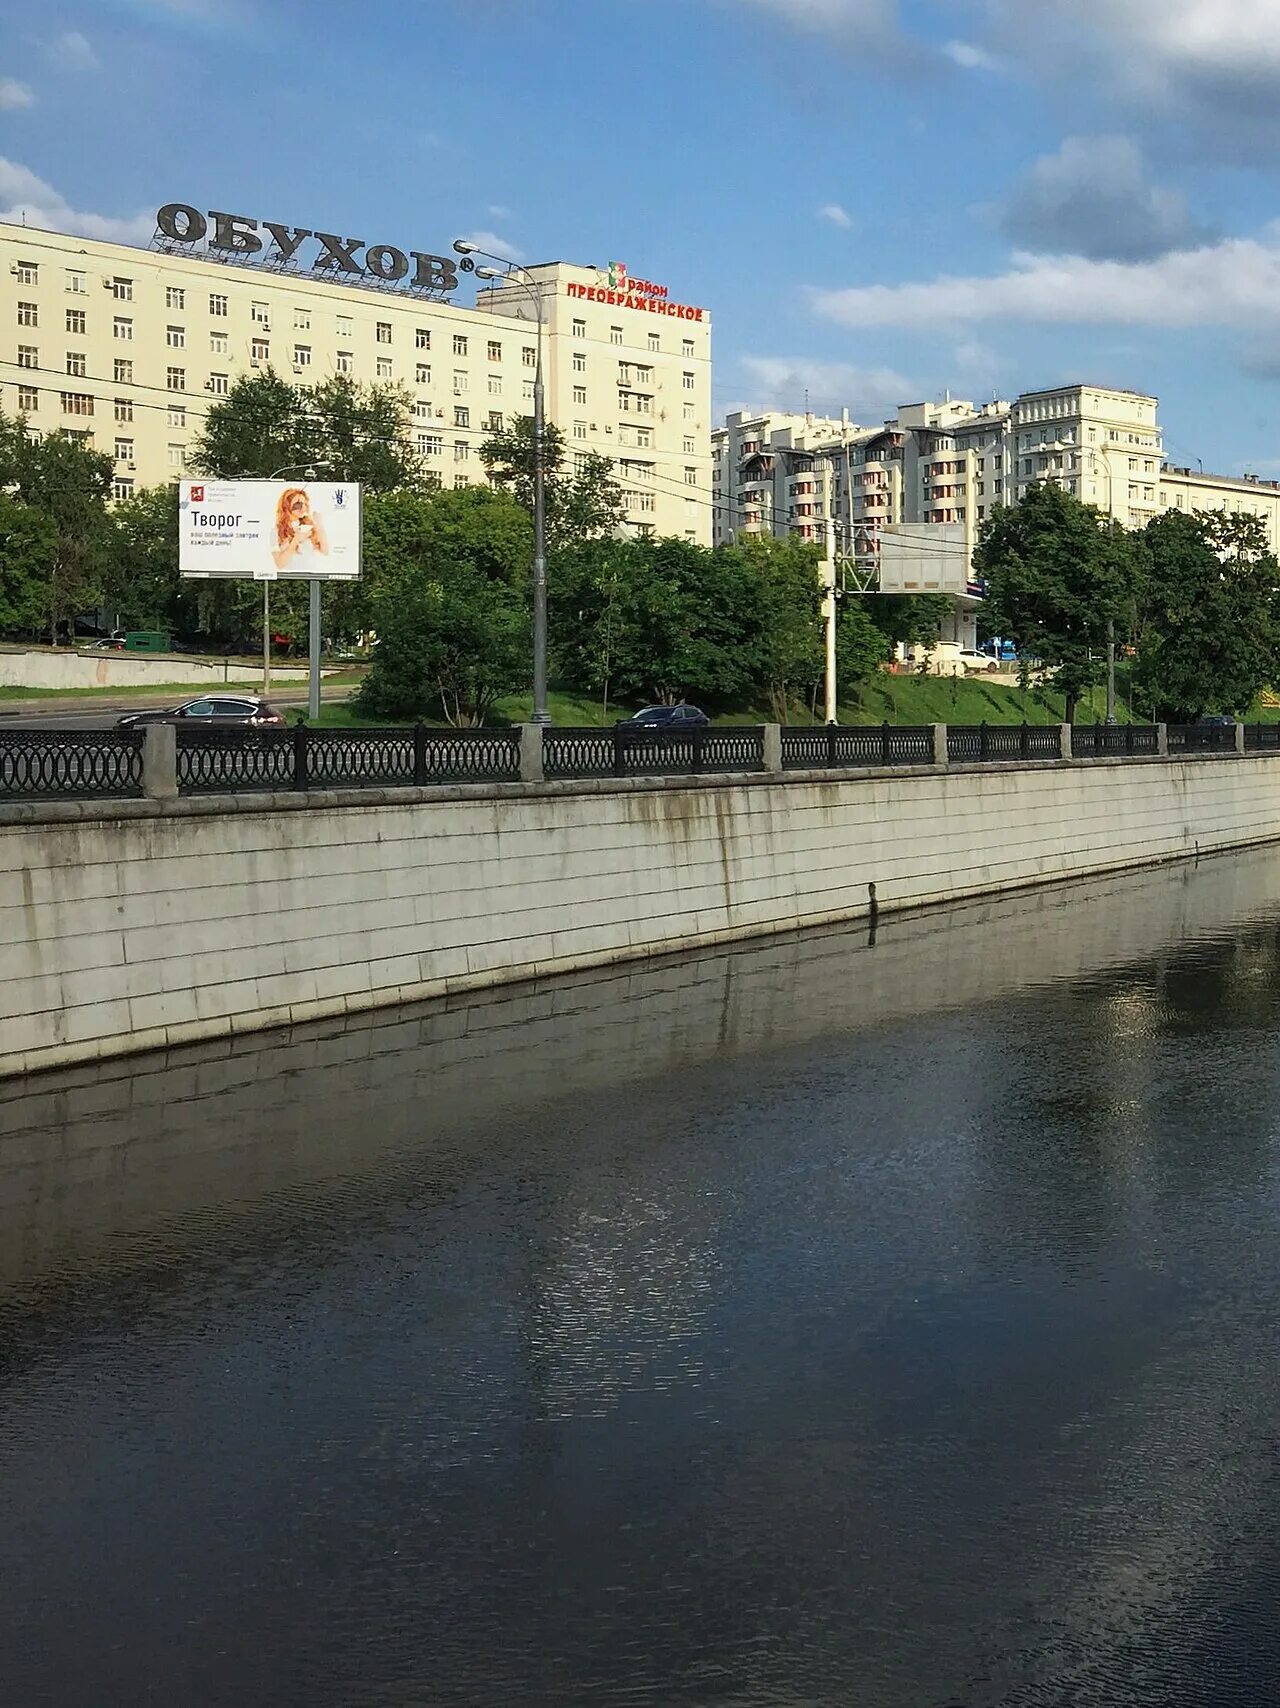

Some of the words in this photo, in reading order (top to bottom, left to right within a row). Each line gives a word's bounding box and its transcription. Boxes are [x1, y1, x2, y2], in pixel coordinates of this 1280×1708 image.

[157, 203, 459, 290] ОБУХОВ
[567, 283, 703, 322] ПРЕОБРАЖЕНСКОЕ
[627, 279, 668, 298] район
[190, 511, 242, 530] Творог
